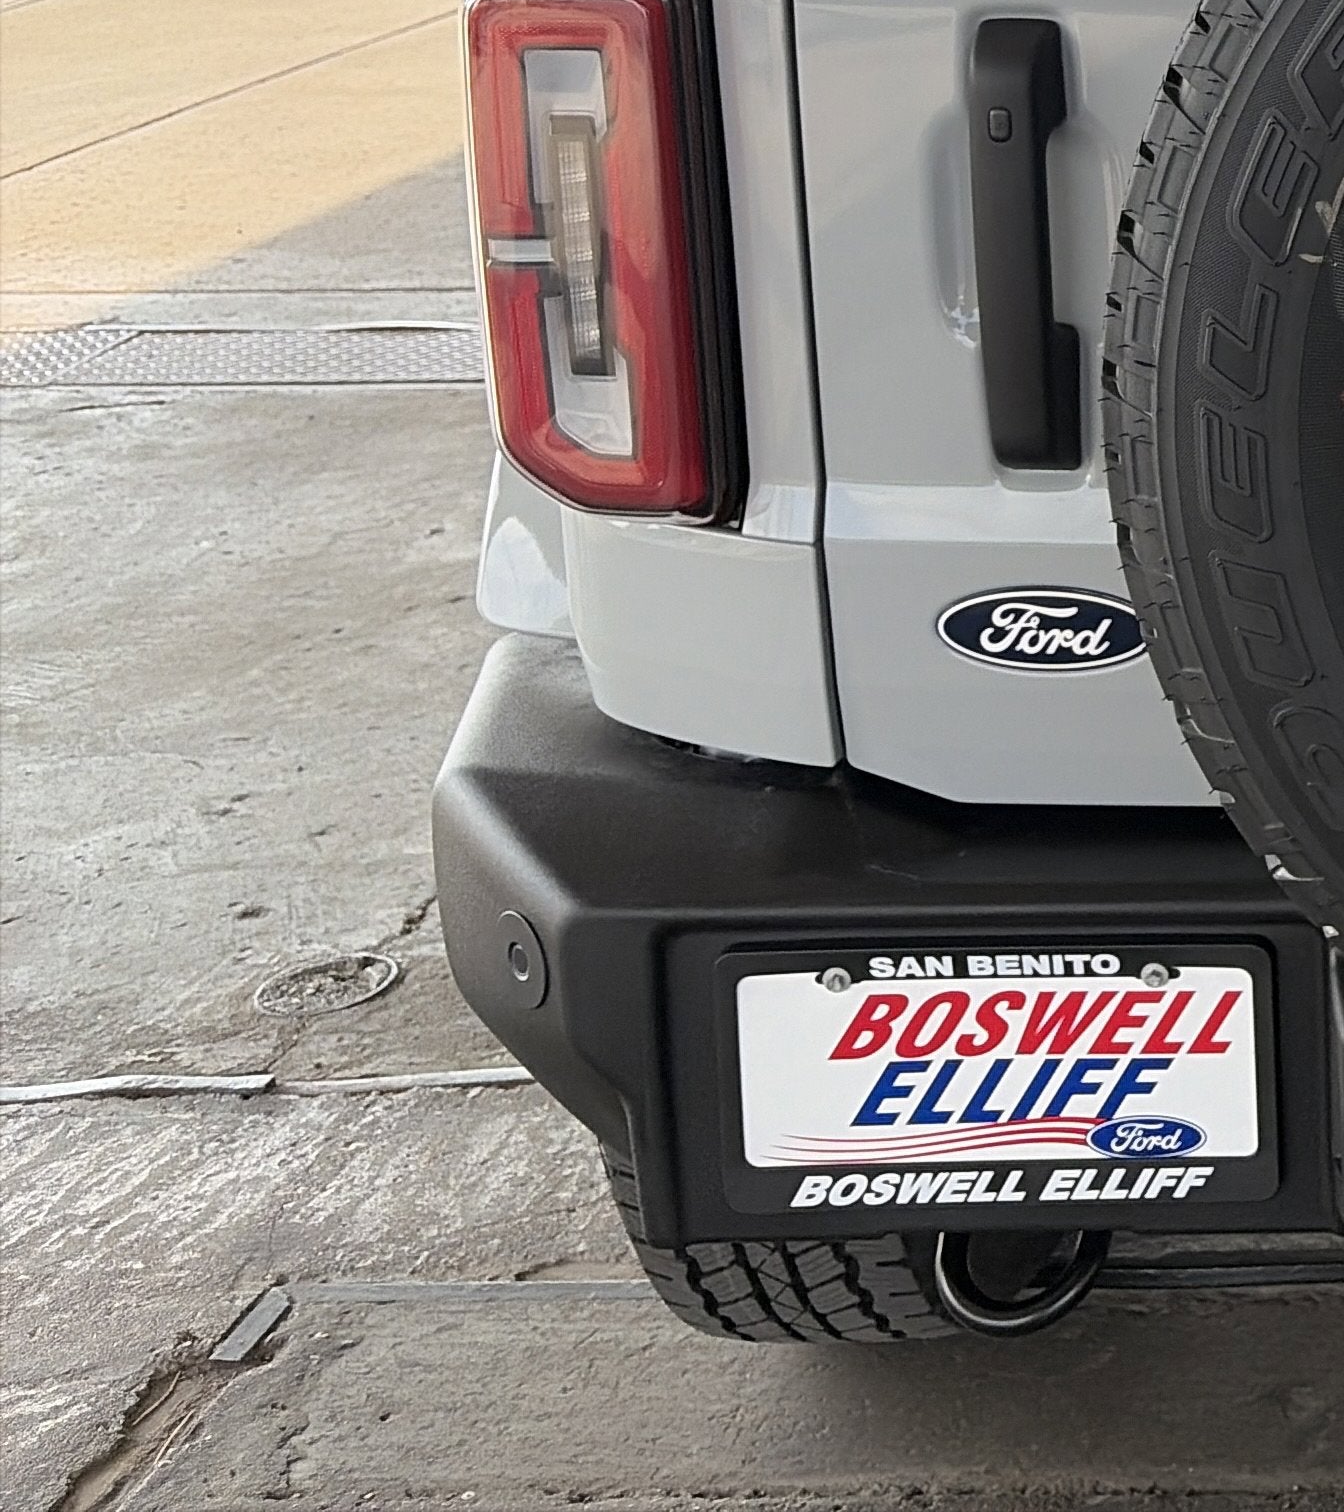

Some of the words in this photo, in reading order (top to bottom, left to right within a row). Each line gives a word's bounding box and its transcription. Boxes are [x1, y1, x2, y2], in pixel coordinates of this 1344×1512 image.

[979, 602, 1113, 656] Ford
[869, 956, 955, 977] SAN
[967, 954, 1121, 976] BENITO
[828, 991, 1242, 1060] BOSWELL
[850, 1057, 1174, 1127] ELLIFF
[1110, 1122, 1181, 1152] Ford
[790, 1173, 1026, 1208] BOSWELL
[1038, 1166, 1214, 1202] ELLIFF
